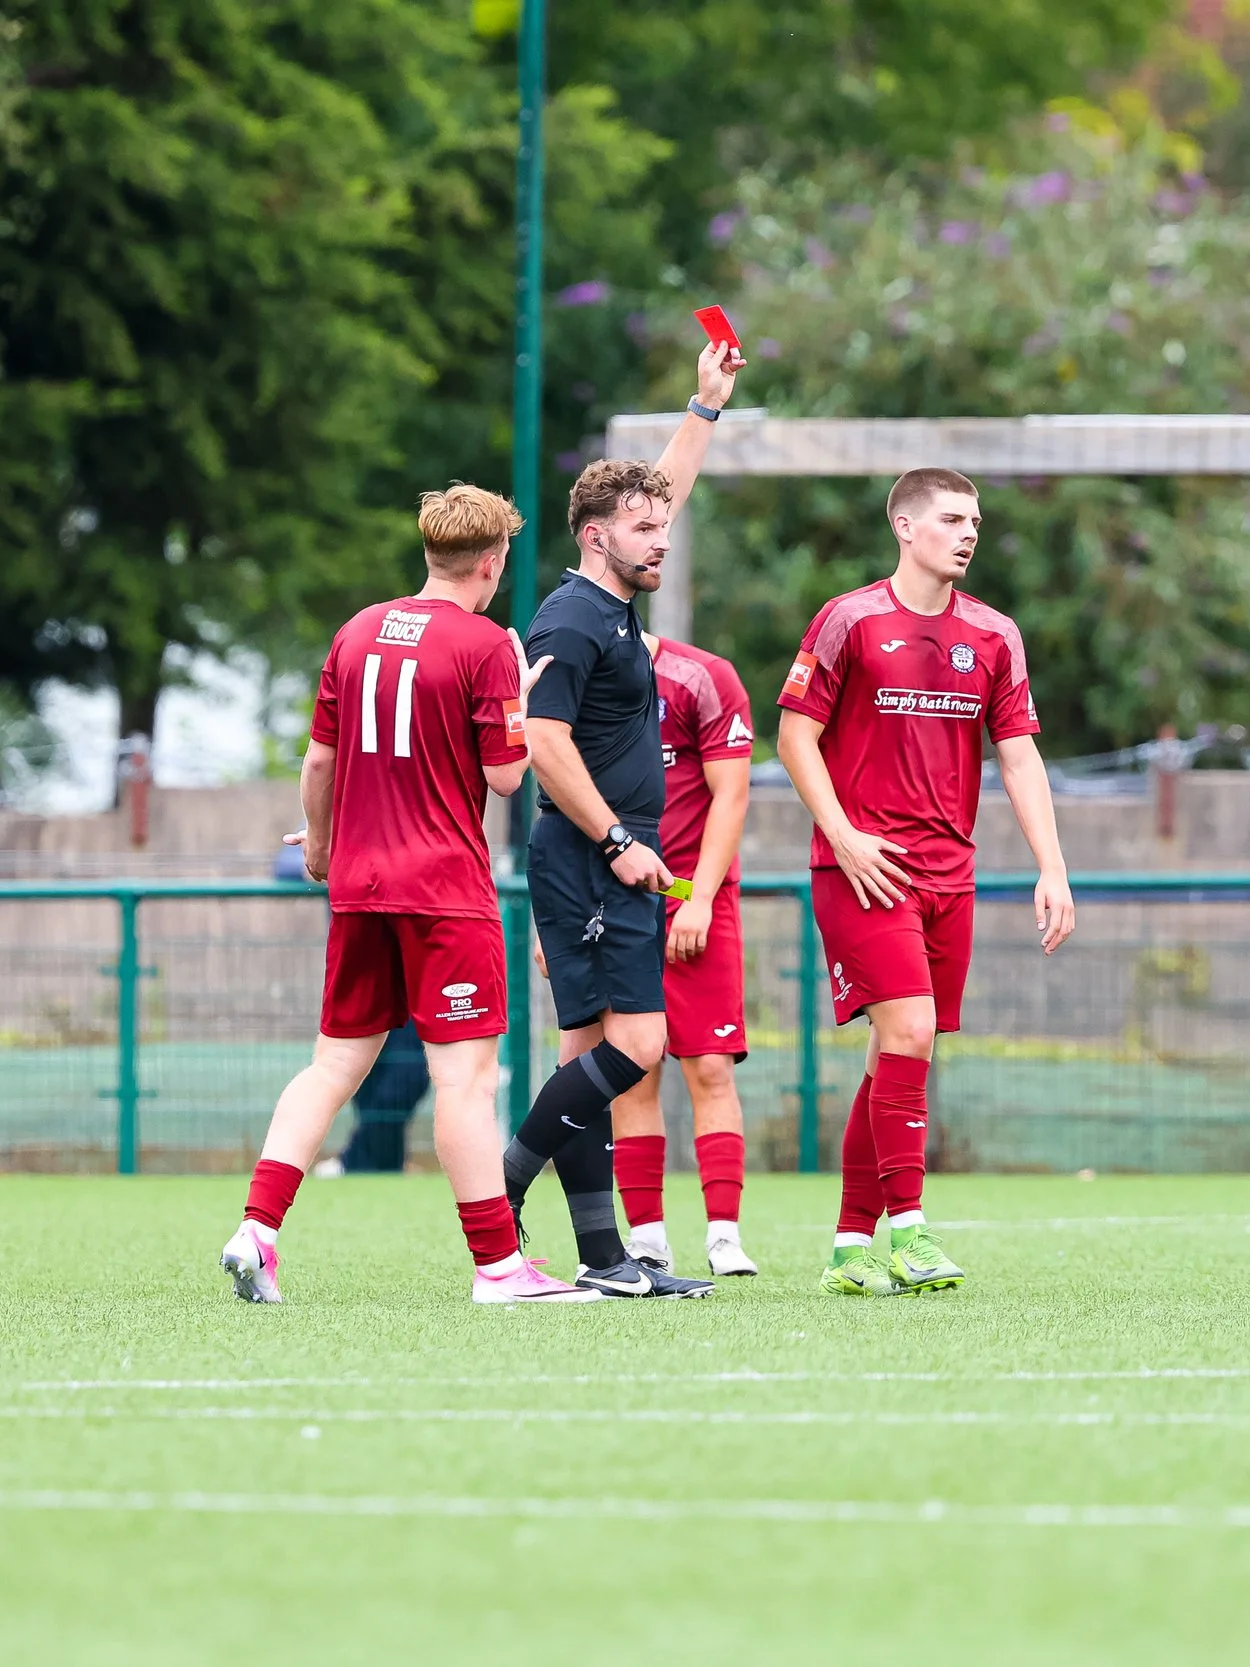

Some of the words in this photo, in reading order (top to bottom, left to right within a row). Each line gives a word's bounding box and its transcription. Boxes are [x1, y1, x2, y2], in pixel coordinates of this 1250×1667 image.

[379, 619, 427, 642] TOUCH
[361, 653, 419, 758] 11
[874, 688, 917, 712] Simply
[918, 695, 983, 719] Bathrooms
[450, 997, 472, 1008] PRO
